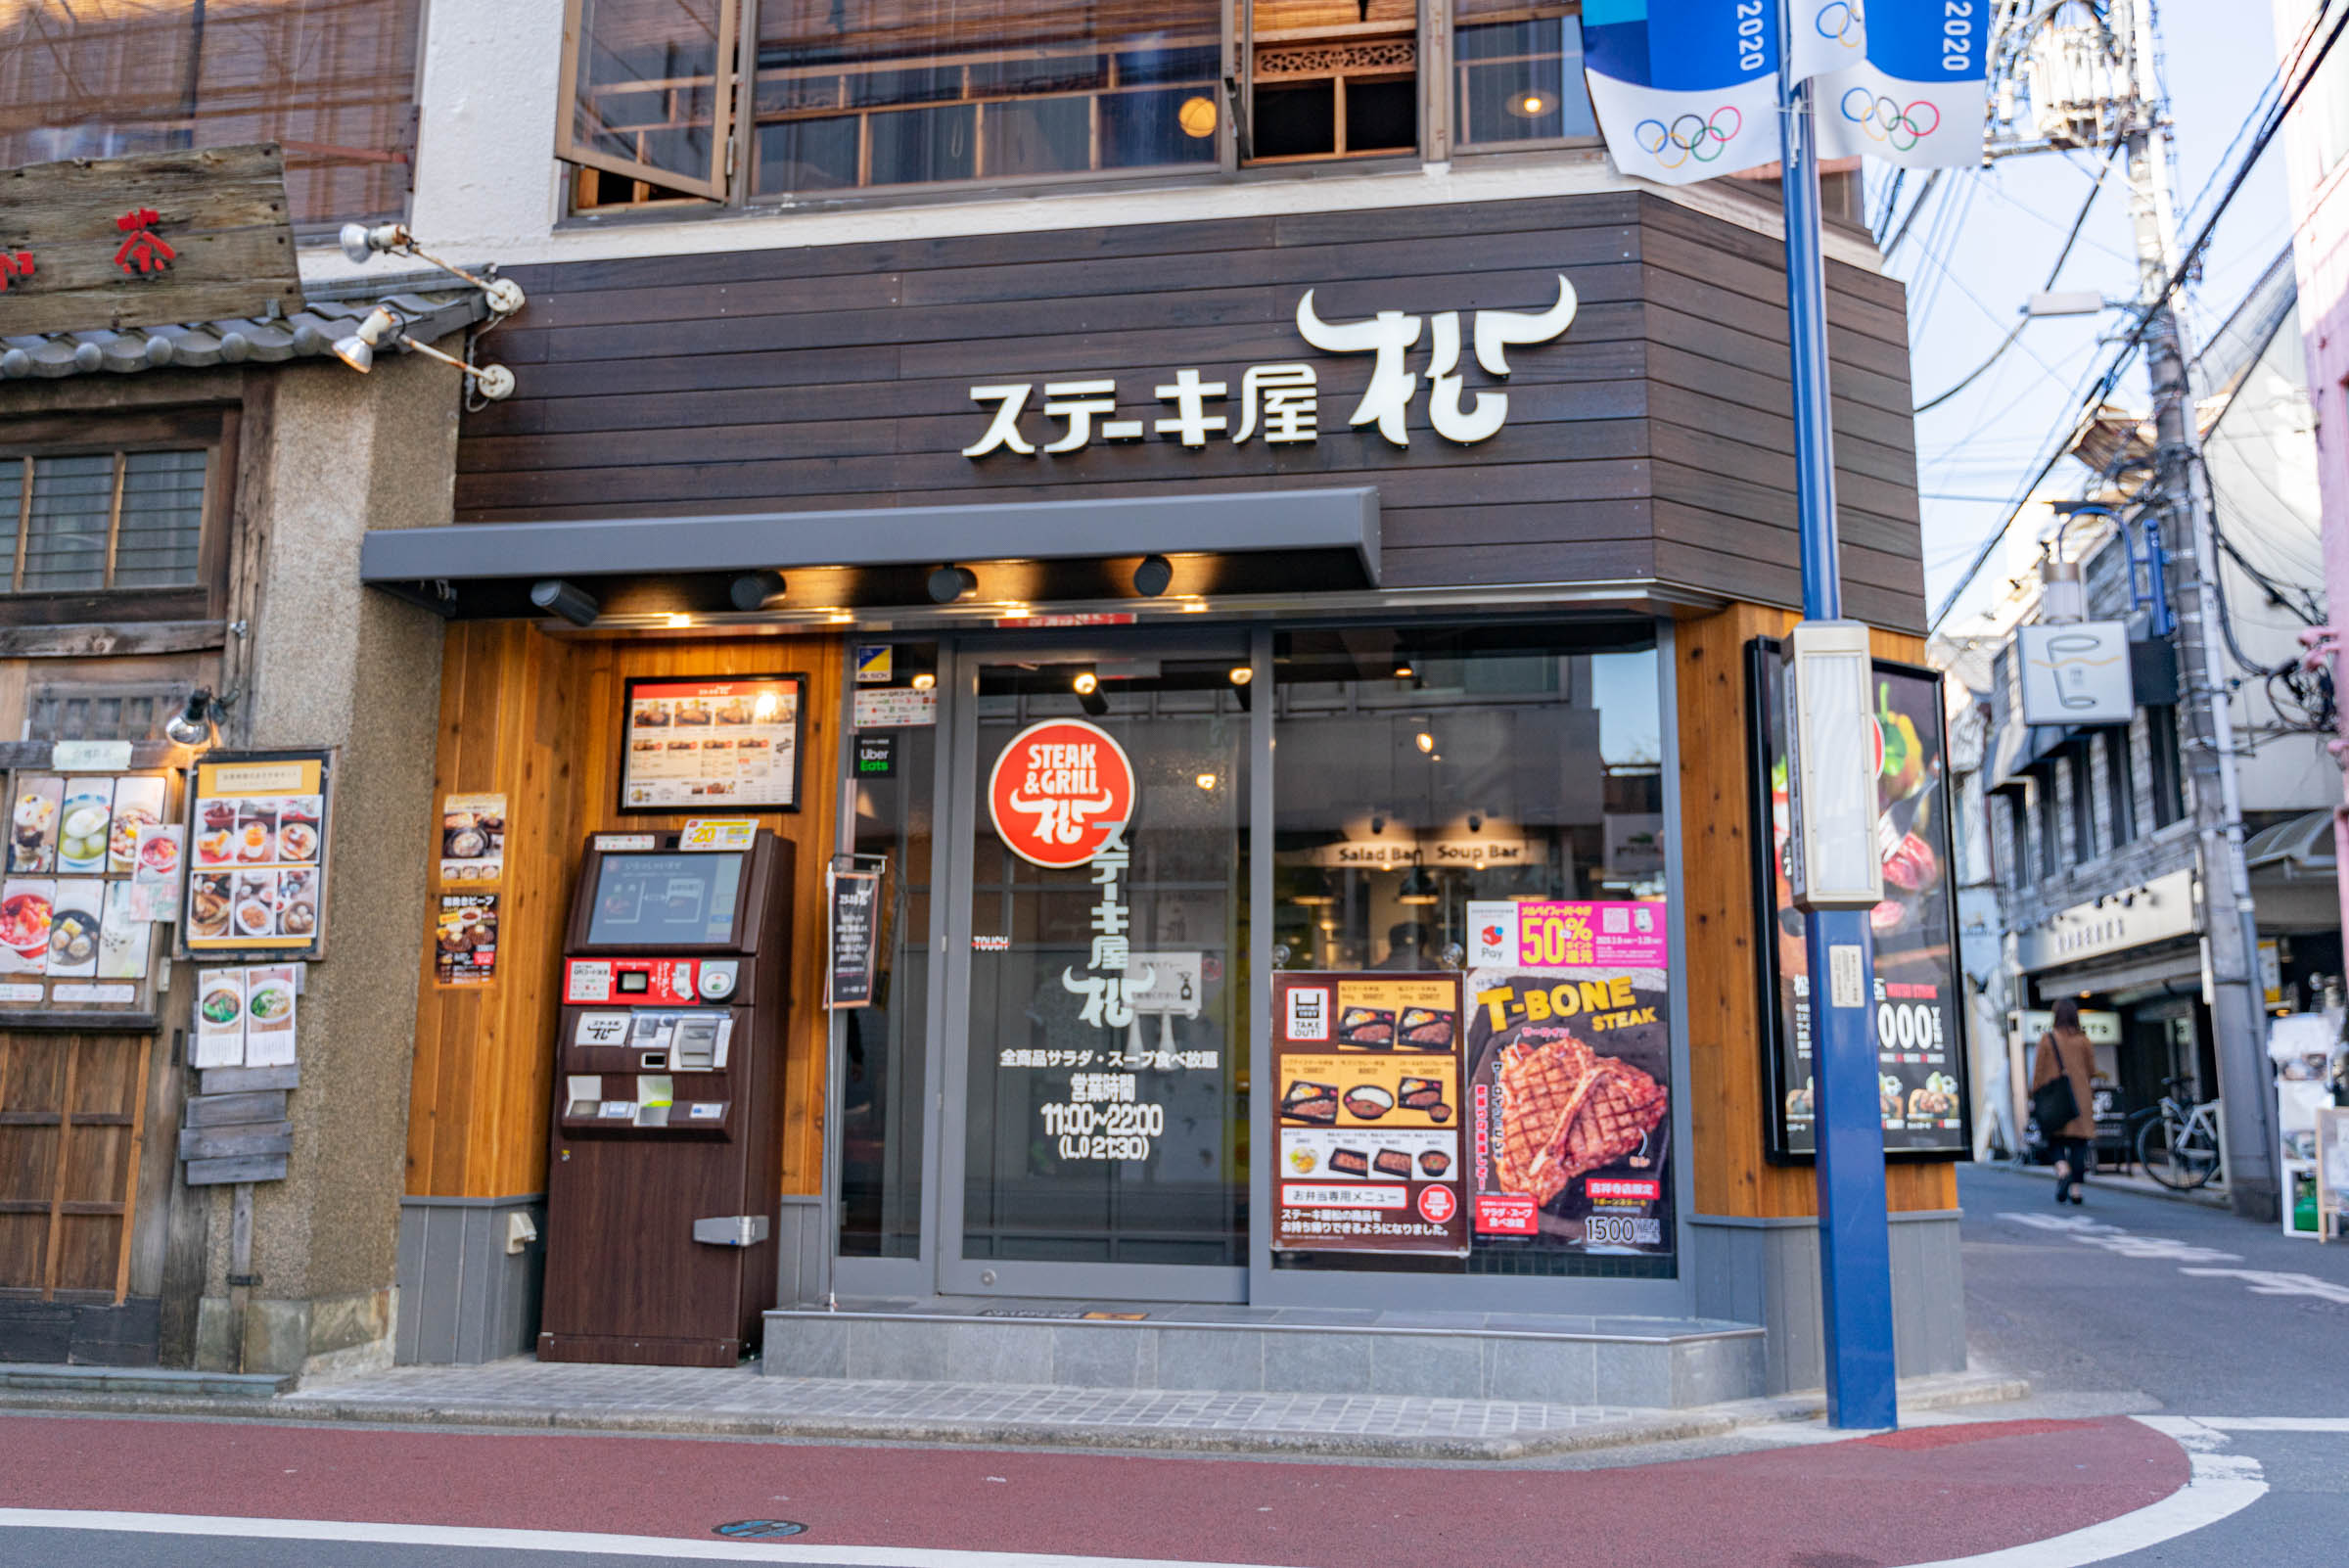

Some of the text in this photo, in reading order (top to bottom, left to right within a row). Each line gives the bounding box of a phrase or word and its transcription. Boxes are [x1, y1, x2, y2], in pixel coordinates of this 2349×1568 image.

[1736, 1, 1765, 71] 2020
[1943, 1, 1972, 71] 2020
[962, 364, 1317, 457] ステーキ屋
[860, 749, 890, 760] Uber
[860, 760, 889, 771] Eats
[1028, 744, 1096, 769] STEAK
[1339, 846, 1420, 861] Salad Bar
[1437, 845, 1519, 860] Soup Bar
[1087, 820, 1129, 970] ステーキ屋
[1481, 946, 1504, 961] Pay
[1521, 917, 1594, 965] 50%
[1476, 976, 1637, 1034] T-BONE
[1591, 1006, 1658, 1033] STEAK
[1877, 1003, 1934, 1050] 000
[1294, 1029, 1320, 1038] OUT!
[999, 1048, 1219, 1069] 全商品サラダ・スープ食べ放題
[1070, 1073, 1136, 1102] 営業時間
[1293, 1190, 1400, 1202] お弁当専用メニュー
[1585, 1217, 1636, 1244] 1500
